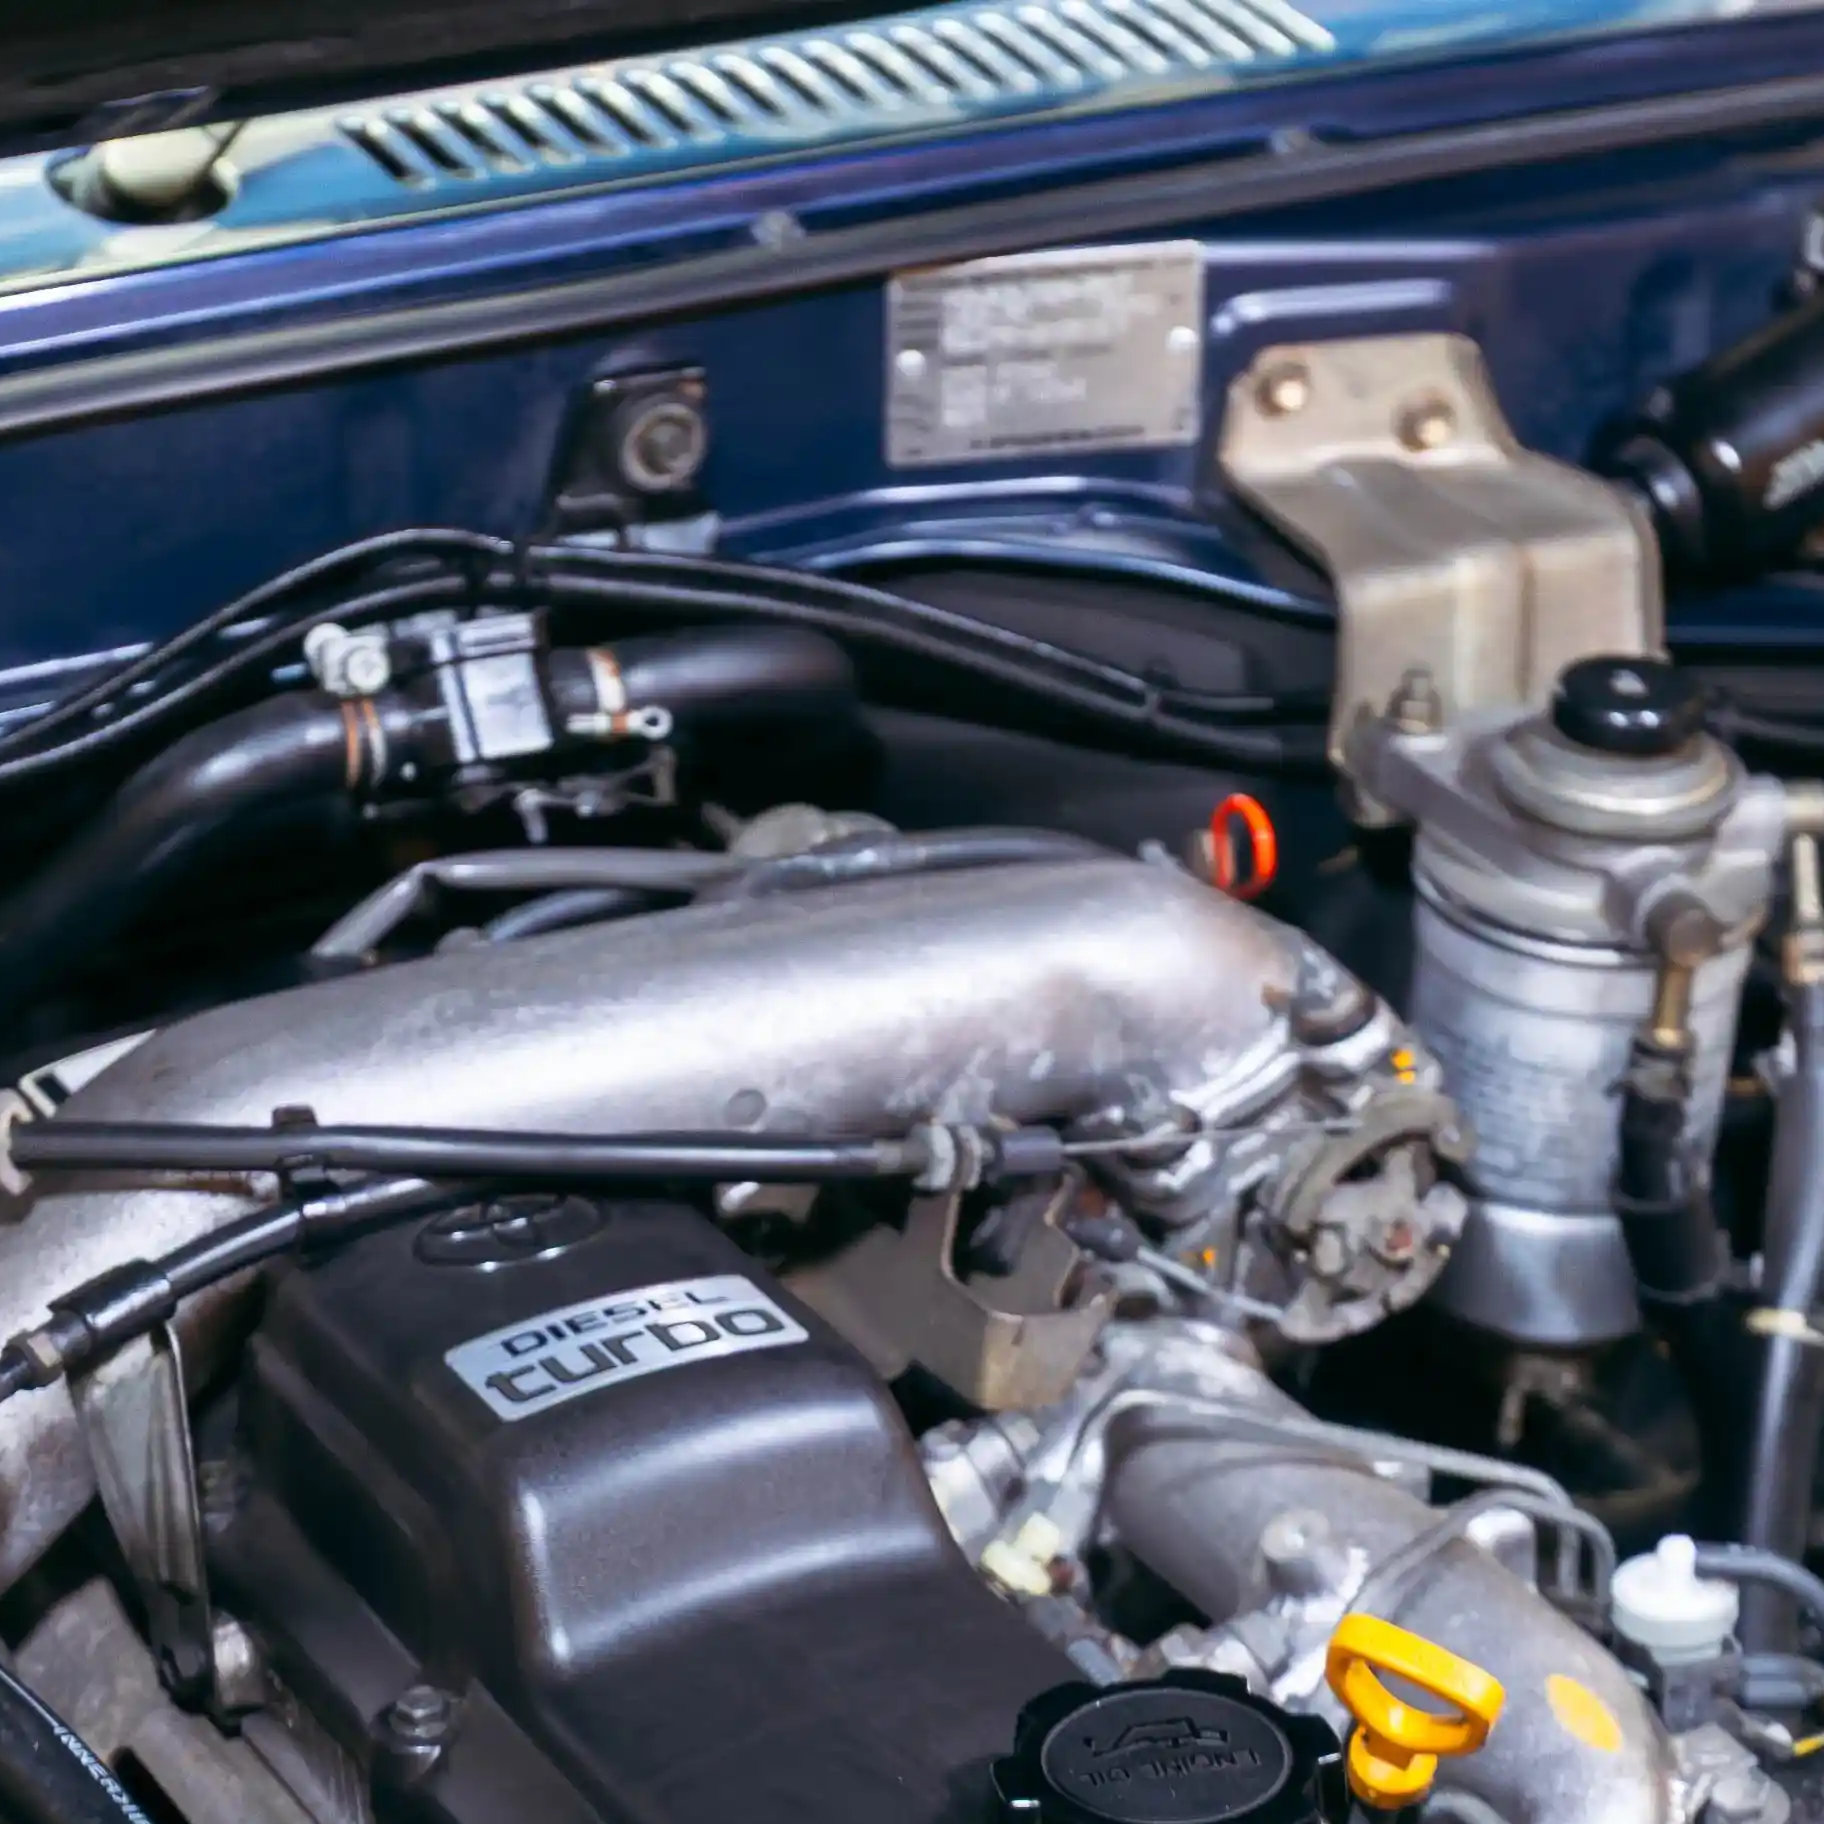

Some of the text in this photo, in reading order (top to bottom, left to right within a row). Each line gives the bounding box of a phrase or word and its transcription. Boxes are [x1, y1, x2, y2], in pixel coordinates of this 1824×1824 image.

[485, 1308, 785, 1404] turbo
[499, 1289, 731, 1358] DIESEL
[1078, 1765, 1133, 1789] OIL
